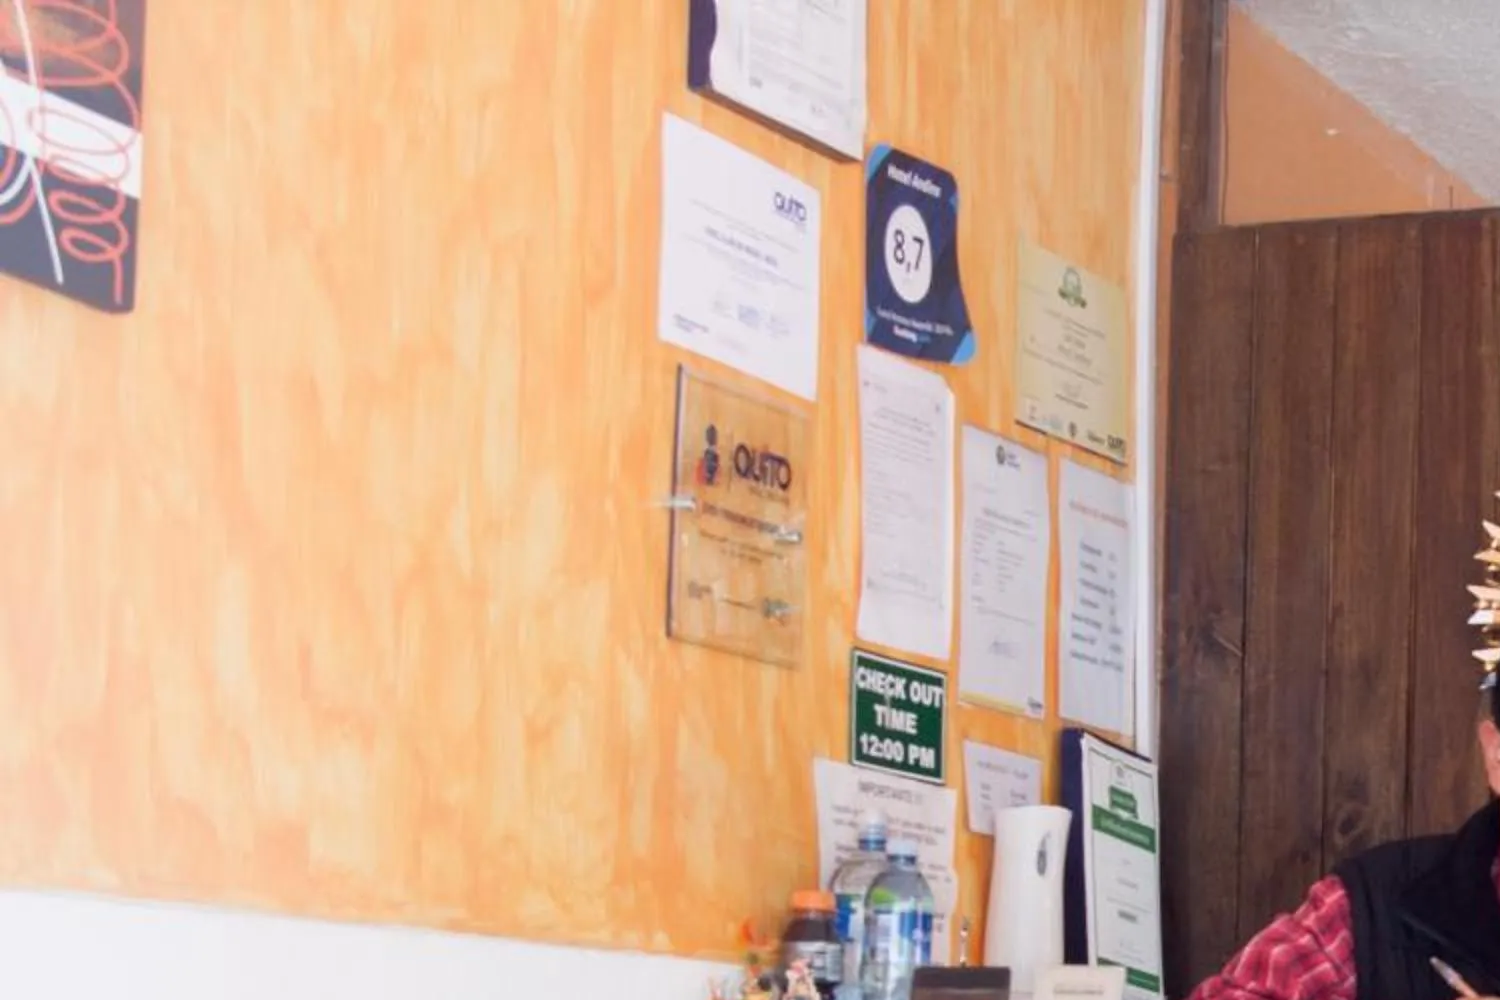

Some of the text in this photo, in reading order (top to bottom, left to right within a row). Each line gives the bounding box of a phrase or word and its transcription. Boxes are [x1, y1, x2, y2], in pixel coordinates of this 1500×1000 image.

[893, 228, 925, 273] 8,7
[734, 442, 792, 491] QUITO
[857, 666, 944, 708] CHECK OUT
[873, 703, 918, 735] TIME
[860, 732, 935, 769] 12:00 PM
